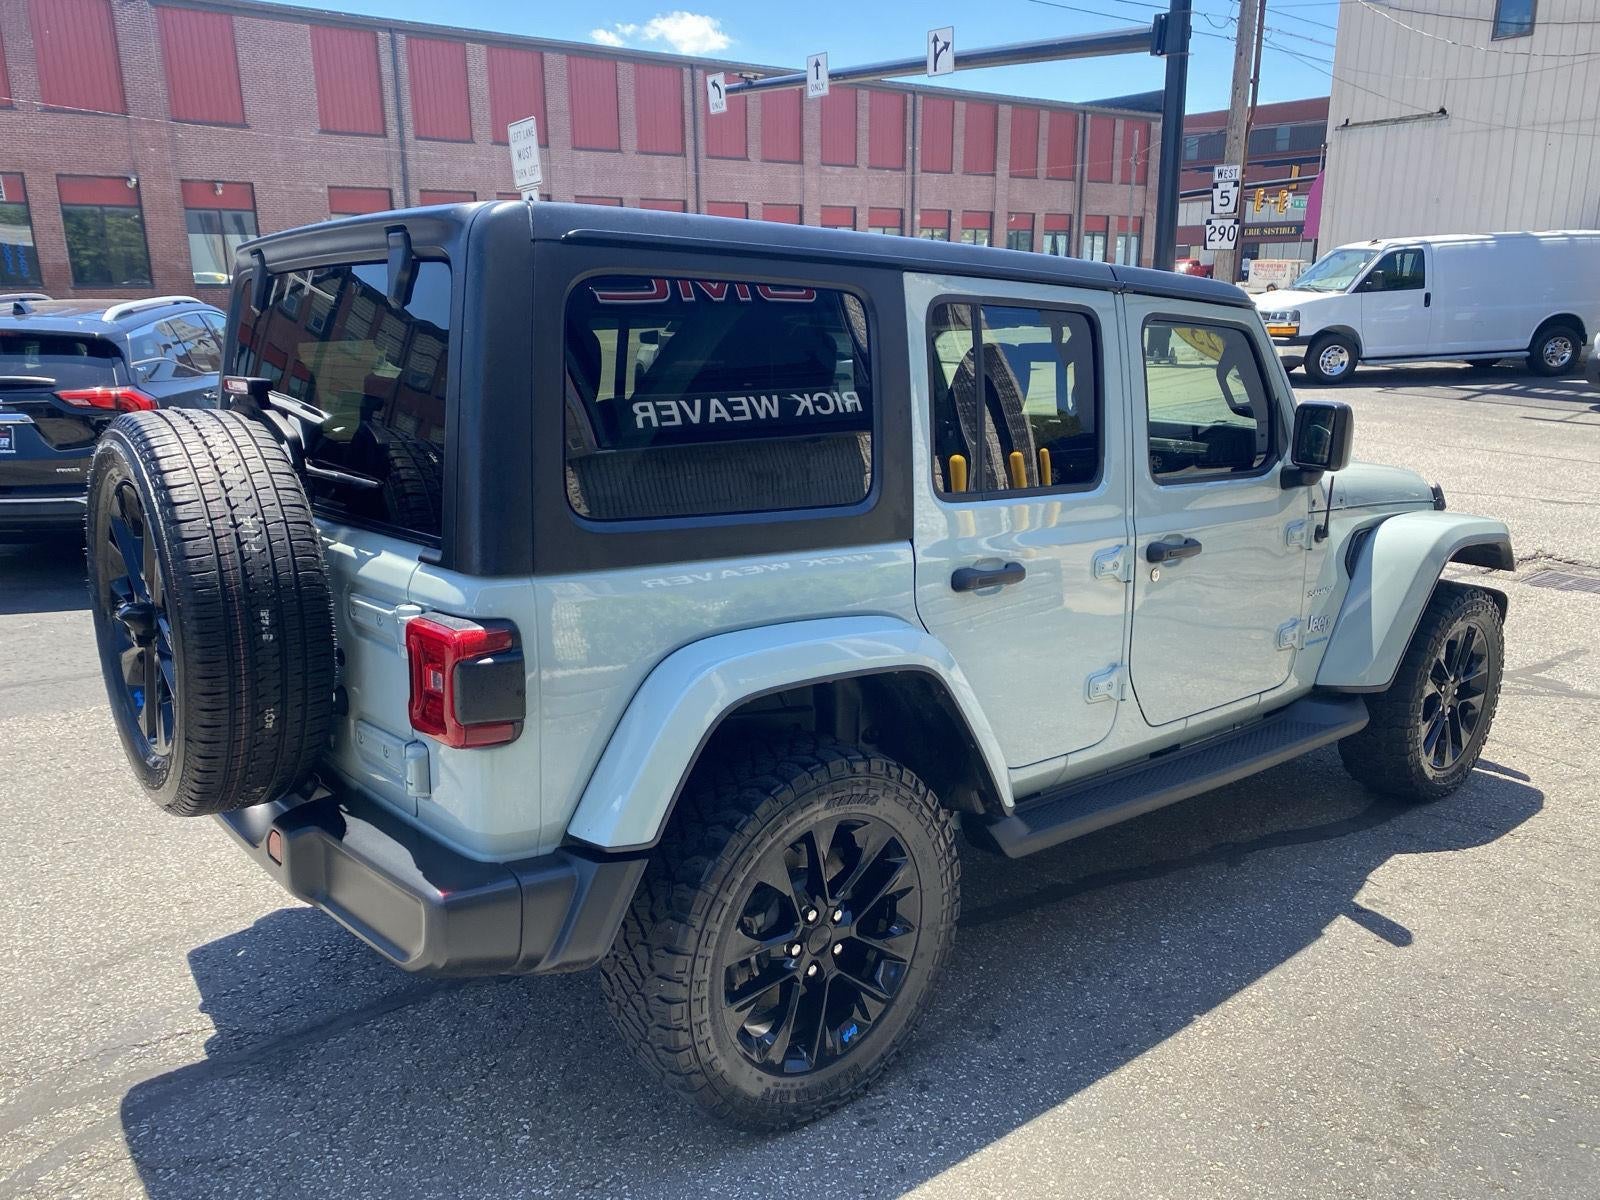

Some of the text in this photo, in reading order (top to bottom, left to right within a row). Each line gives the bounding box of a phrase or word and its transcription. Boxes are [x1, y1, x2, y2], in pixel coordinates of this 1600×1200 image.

[811, 82, 825, 92] ONLY
[711, 101, 724, 110] ONLY
[512, 127, 535, 143] LEFT LANE
[517, 145, 532, 160] MUST
[516, 164, 539, 179] TURN LEFT
[1217, 168, 1238, 179] WEST
[1219, 190, 1231, 207] 5
[1208, 225, 1236, 242] 290
[1243, 226, 1297, 236] ERIE SISTIBLE
[1307, 615, 1330, 633] Jeep
